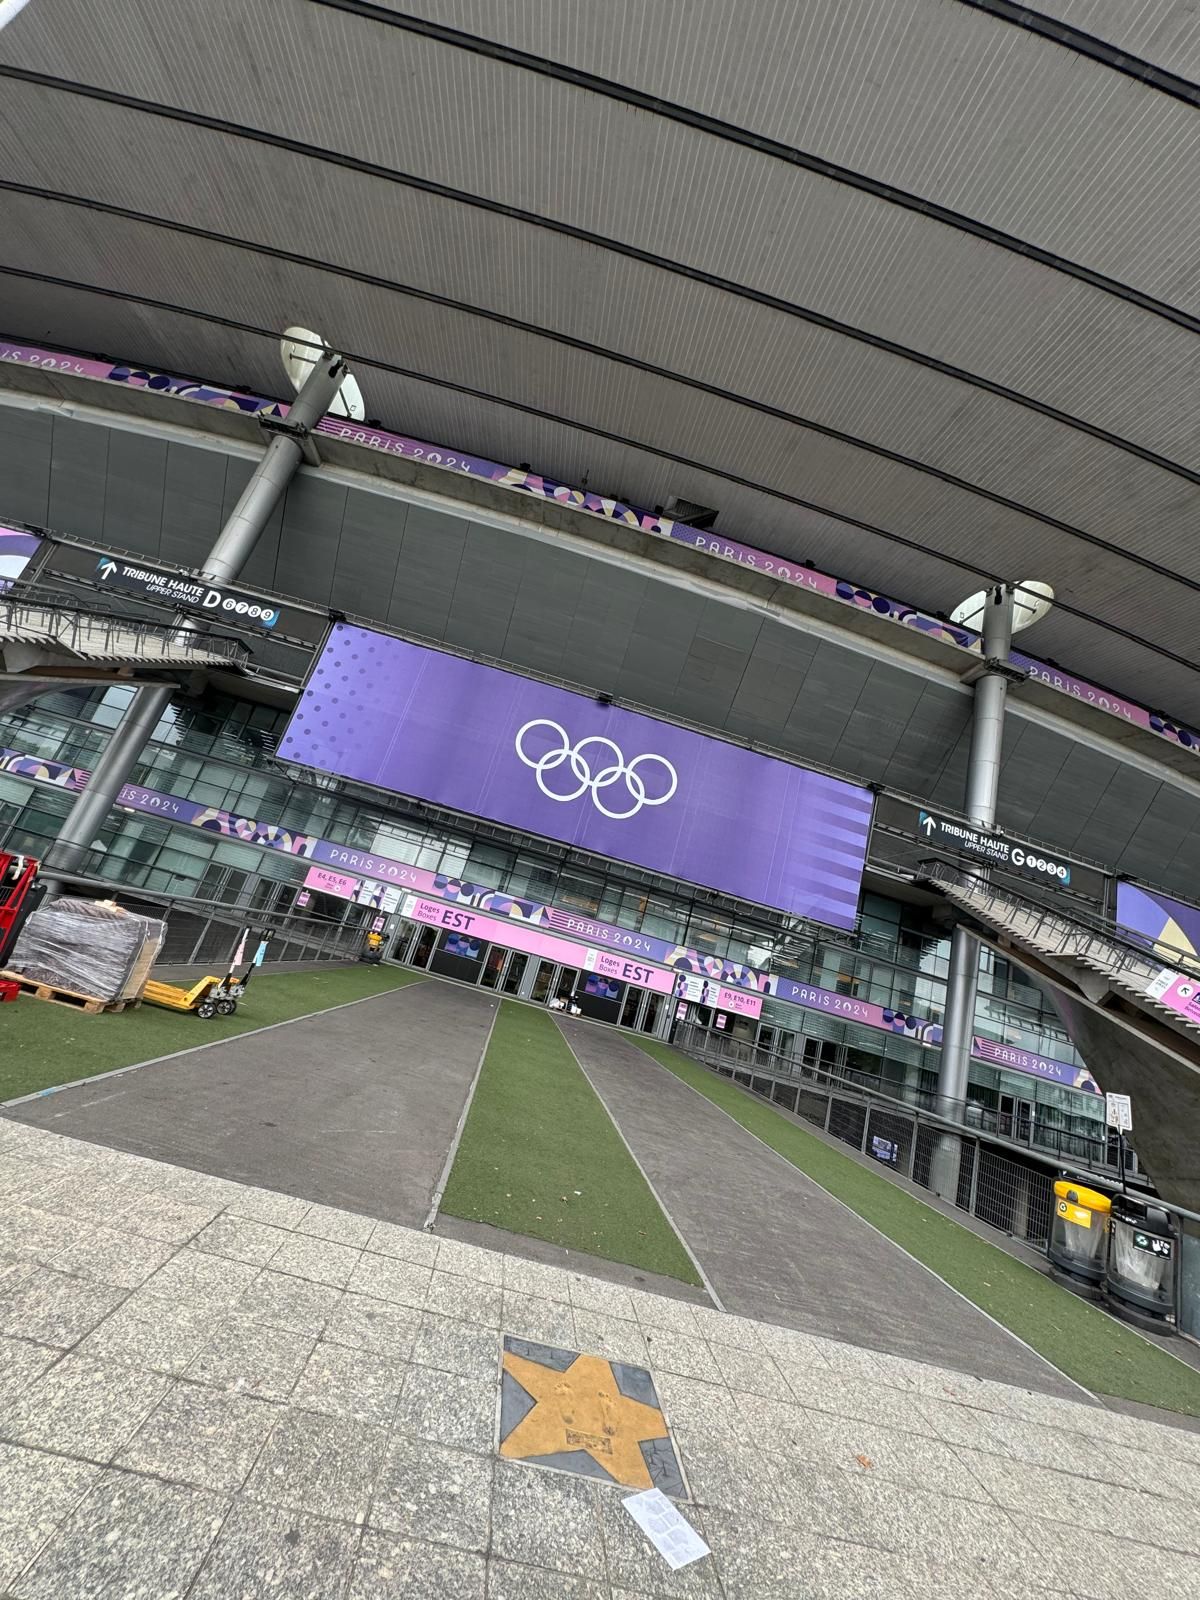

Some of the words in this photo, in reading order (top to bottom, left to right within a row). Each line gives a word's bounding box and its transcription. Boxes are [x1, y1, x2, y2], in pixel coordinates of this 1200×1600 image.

[339, 428, 405, 453] PARIS
[414, 448, 470, 472] 2024
[696, 536, 756, 566] PARIS
[765, 561, 816, 588] 2024
[122, 566, 167, 587] TRIBUNE
[168, 579, 204, 597] HAUTE
[146, 584, 172, 596] UPPER
[172, 590, 199, 604] STAND
[1030, 666, 1080, 696] PARIS
[140, 794, 180, 814] 2024
[940, 822, 978, 843] TRIBUNE
[980, 836, 1010, 854] HAUTE
[964, 840, 986, 853] UPPER
[986, 849, 1008, 861] STAND
[330, 850, 374, 870] PARIS
[378, 864, 416, 883] 2024
[418, 910, 436, 922] Boxes
[420, 902, 440, 914] Loges
[442, 910, 476, 930] EST
[567, 918, 609, 939] PARIS
[614, 932, 650, 952] 2024
[598, 964, 618, 975] Boxes
[600, 956, 620, 968] Loges
[622, 963, 654, 984] EST
[792, 986, 830, 1006] PARIS
[834, 1000, 868, 1017] 2024
[994, 1048, 1028, 1066] PARIS
[1032, 1059, 1061, 1077] 2024
